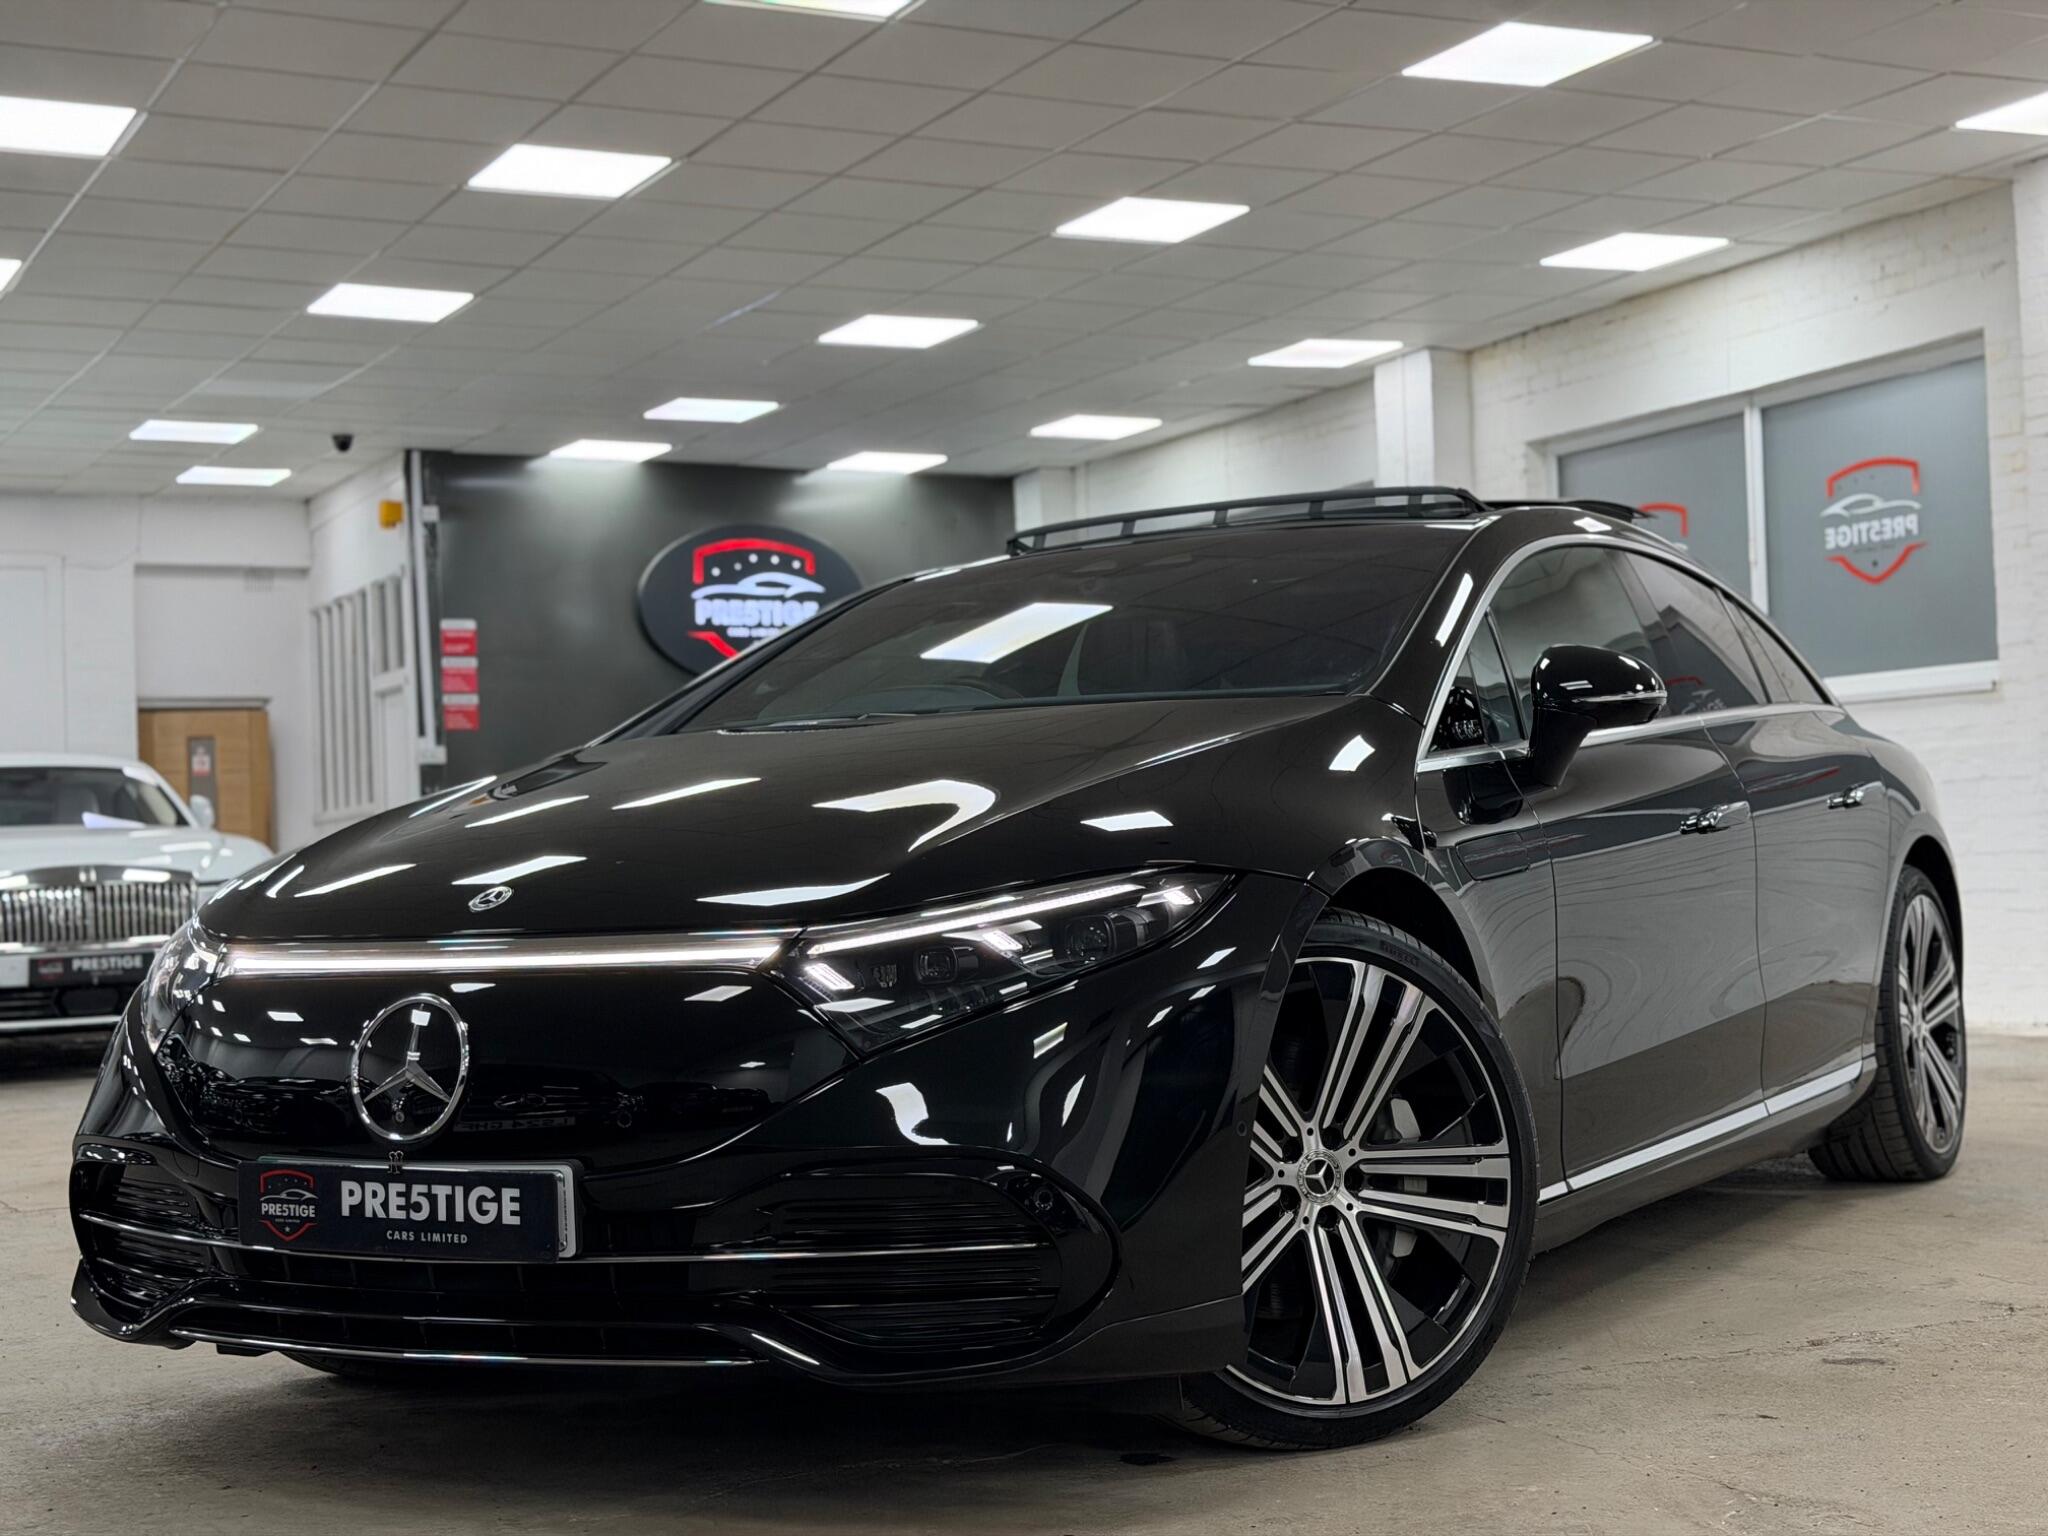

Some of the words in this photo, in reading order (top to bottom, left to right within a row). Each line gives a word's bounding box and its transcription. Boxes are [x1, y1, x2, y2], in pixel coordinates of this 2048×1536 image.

[341, 1180, 521, 1225] PRE5TIGE
[386, 1230, 415, 1241] CARS
[420, 1232, 468, 1244] LIMITED
